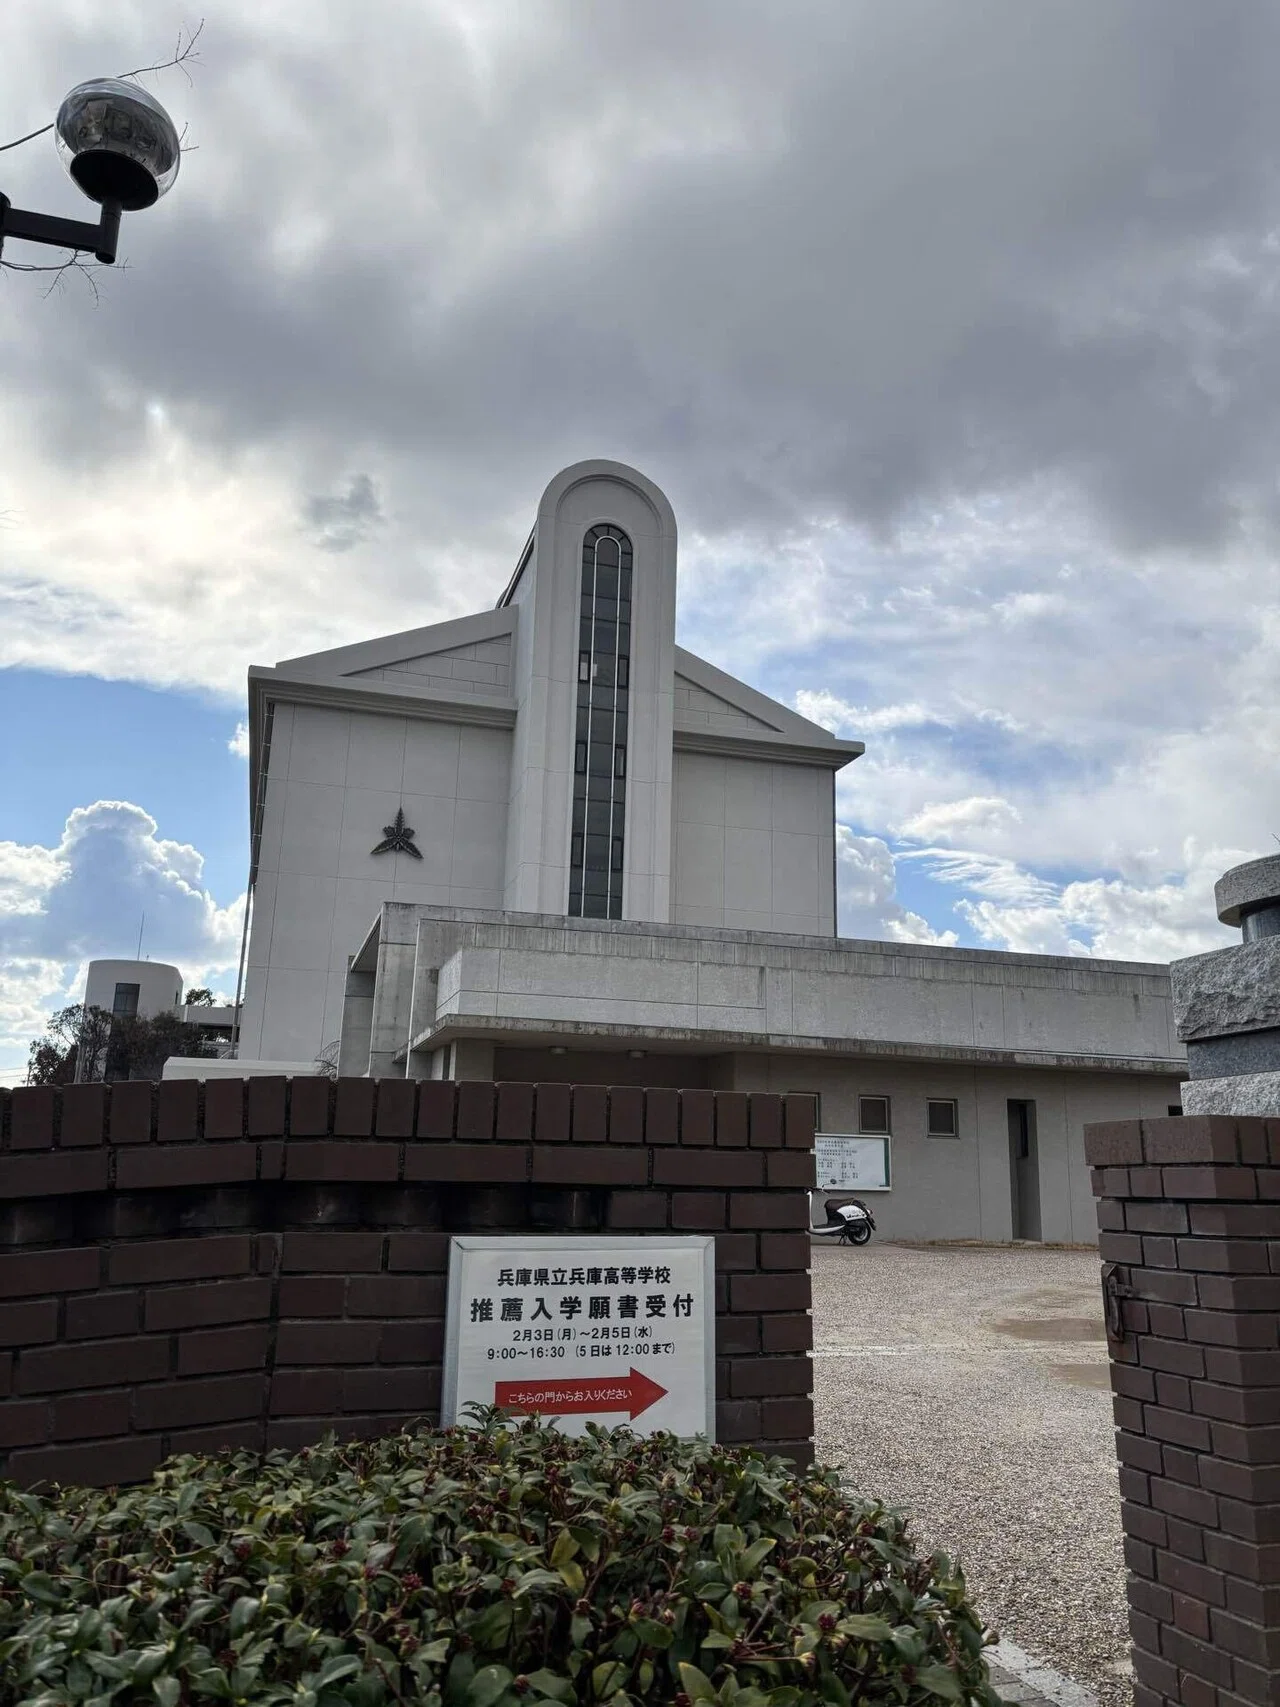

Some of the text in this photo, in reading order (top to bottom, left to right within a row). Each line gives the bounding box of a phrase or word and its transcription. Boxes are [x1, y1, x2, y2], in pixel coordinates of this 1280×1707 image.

[497, 1266, 671, 1287] 兵庫県立兵庫高等学校
[470, 1293, 694, 1323] 推薦入学願書受付
[508, 1388, 633, 1404] こちらの門からお入りください
